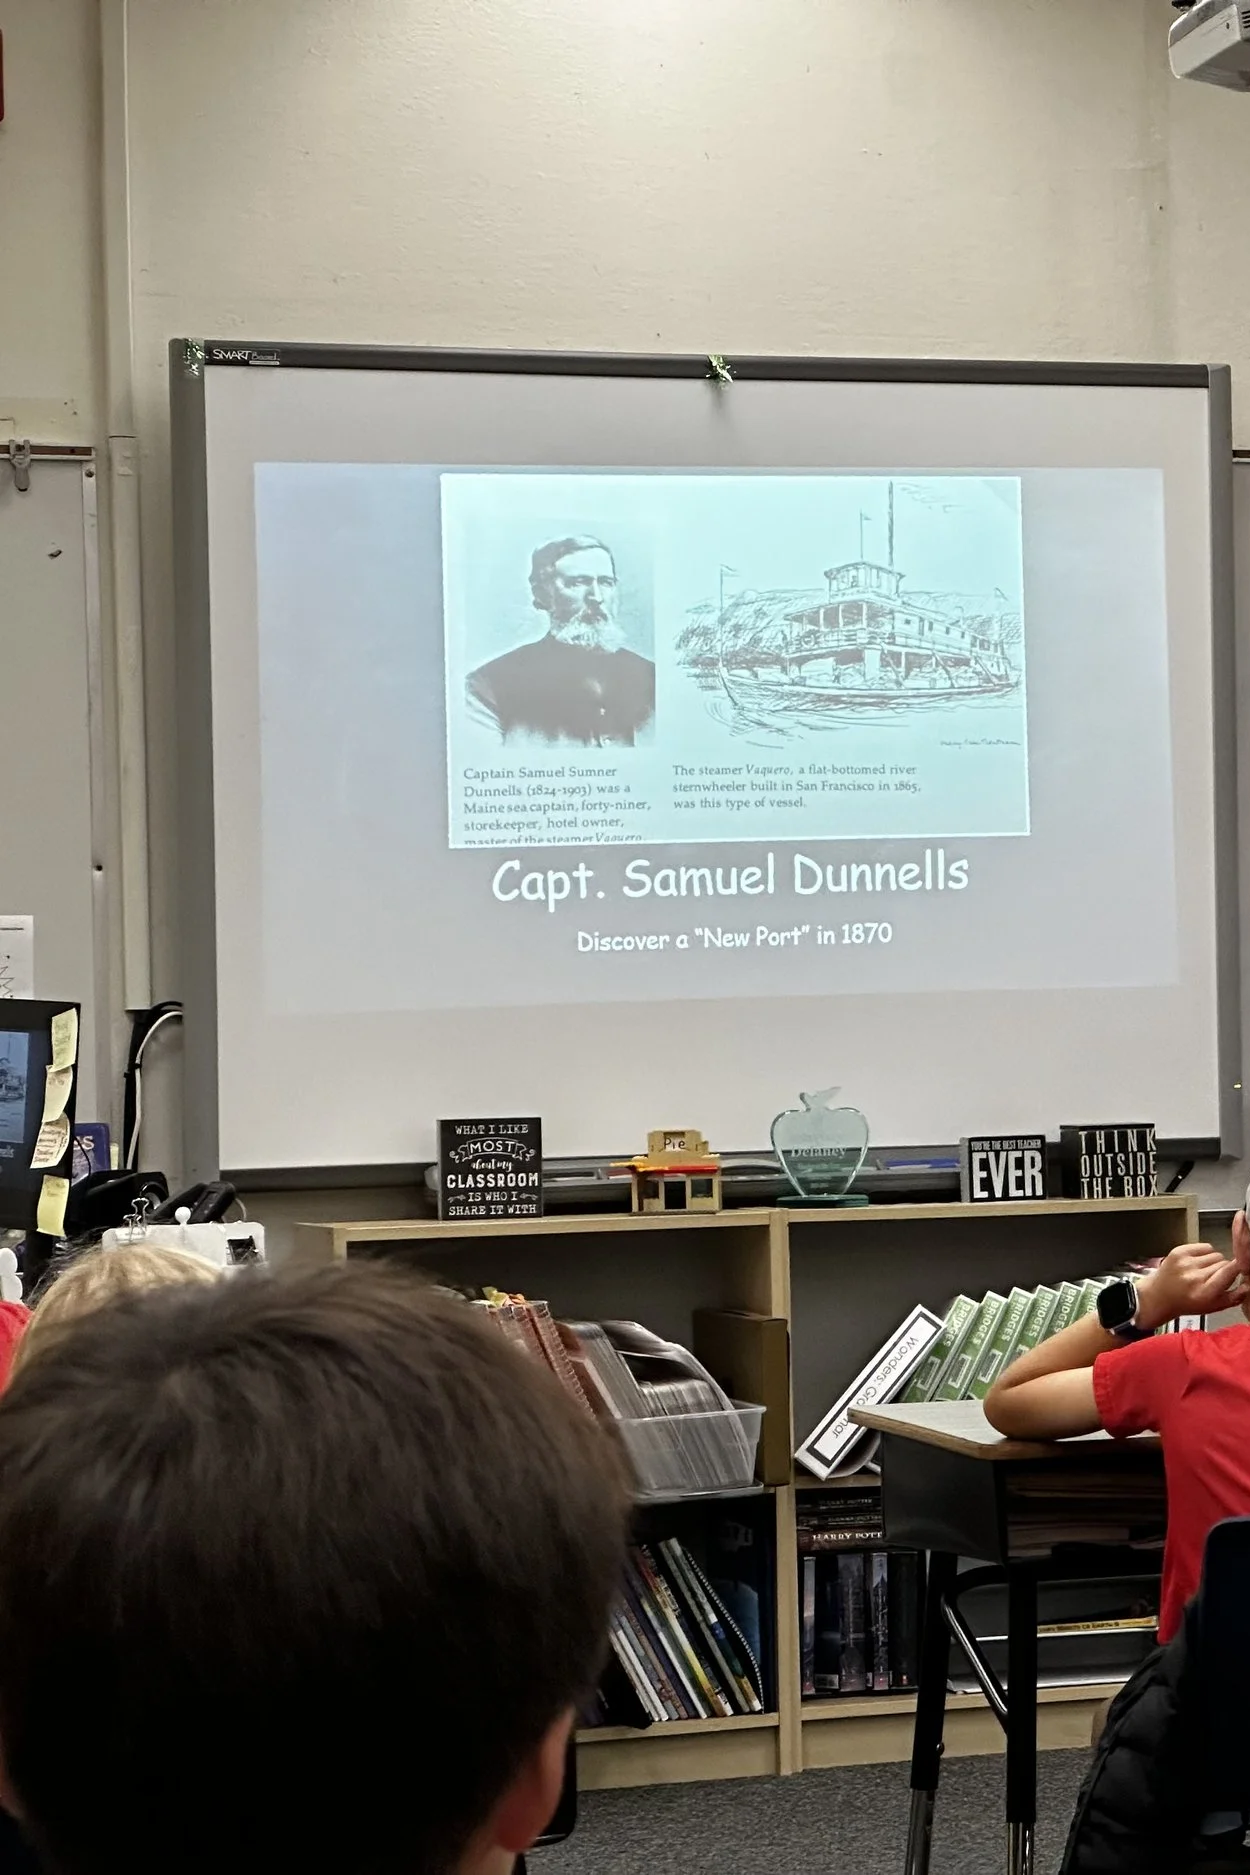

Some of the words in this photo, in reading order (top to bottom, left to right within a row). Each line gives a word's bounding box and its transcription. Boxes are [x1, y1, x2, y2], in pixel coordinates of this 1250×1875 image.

[212, 349, 251, 361] SMART
[464, 768, 514, 782] Captain
[519, 767, 565, 779] Samuel
[569, 766, 617, 778] Sumner
[673, 765, 695, 776] The
[699, 765, 743, 776] steamer
[746, 764, 793, 777] Vaquero,
[799, 766, 805, 775] a
[808, 764, 885, 775] flat-bottomed
[890, 765, 917, 775] river
[464, 785, 522, 798] Dunnells
[527, 784, 592, 797] (1824-1903)
[597, 785, 620, 793] was
[624, 785, 631, 793] a
[673, 781, 746, 793] sternwheeler
[751, 781, 777, 792] built
[781, 781, 793, 791] in
[796, 781, 818, 791] San
[821, 781, 874, 792] Francisco
[878, 781, 890, 791] in
[464, 802, 504, 814] Maine
[507, 805, 527, 813] sea
[529, 802, 579, 815] captain,
[581, 799, 651, 813] forty-niner,
[674, 799, 696, 809] was
[700, 798, 722, 809] this
[725, 798, 751, 811] type
[755, 797, 765, 808] of
[769, 797, 806, 809] vessel.
[464, 818, 542, 833] storekeeper,
[547, 817, 577, 828] hotel
[582, 818, 624, 829] owner,
[492, 859, 605, 913] Capt.
[622, 852, 775, 898] Samuel
[794, 848, 970, 895] Dunnells
[577, 930, 670, 952] Discover
[676, 934, 689, 949] a
[816, 925, 836, 944] in
[842, 922, 893, 944] 1870
[455, 1125, 485, 1135] WHAT
[488, 1124, 495, 1134] I
[499, 1124, 529, 1134] LIKE
[470, 1140, 515, 1153] MOST
[663, 1137, 686, 1150] Pie
[1079, 1128, 1157, 1154] THINK
[791, 1146, 846, 1159] Delaney
[1081, 1152, 1157, 1178] OUTSIDE
[446, 1172, 539, 1189] CLASSROOM
[972, 1150, 1044, 1199] EVER
[1081, 1177, 1113, 1199] THE
[1124, 1175, 1158, 1199] BOX
[468, 1192, 481, 1202] IS
[485, 1191, 508, 1201] WHO
[511, 1191, 518, 1201] I
[449, 1206, 486, 1216] SHARE
[490, 1205, 504, 1215] IT
[507, 1204, 537, 1214] WITH
[972, 1298, 999, 1345] BRIDGES
[1001, 1295, 1026, 1342] BRIDGES
[1029, 1292, 1051, 1338] BRIDGES
[873, 1336, 919, 1386] Wonders:
[812, 1533, 853, 1541] HARRY
